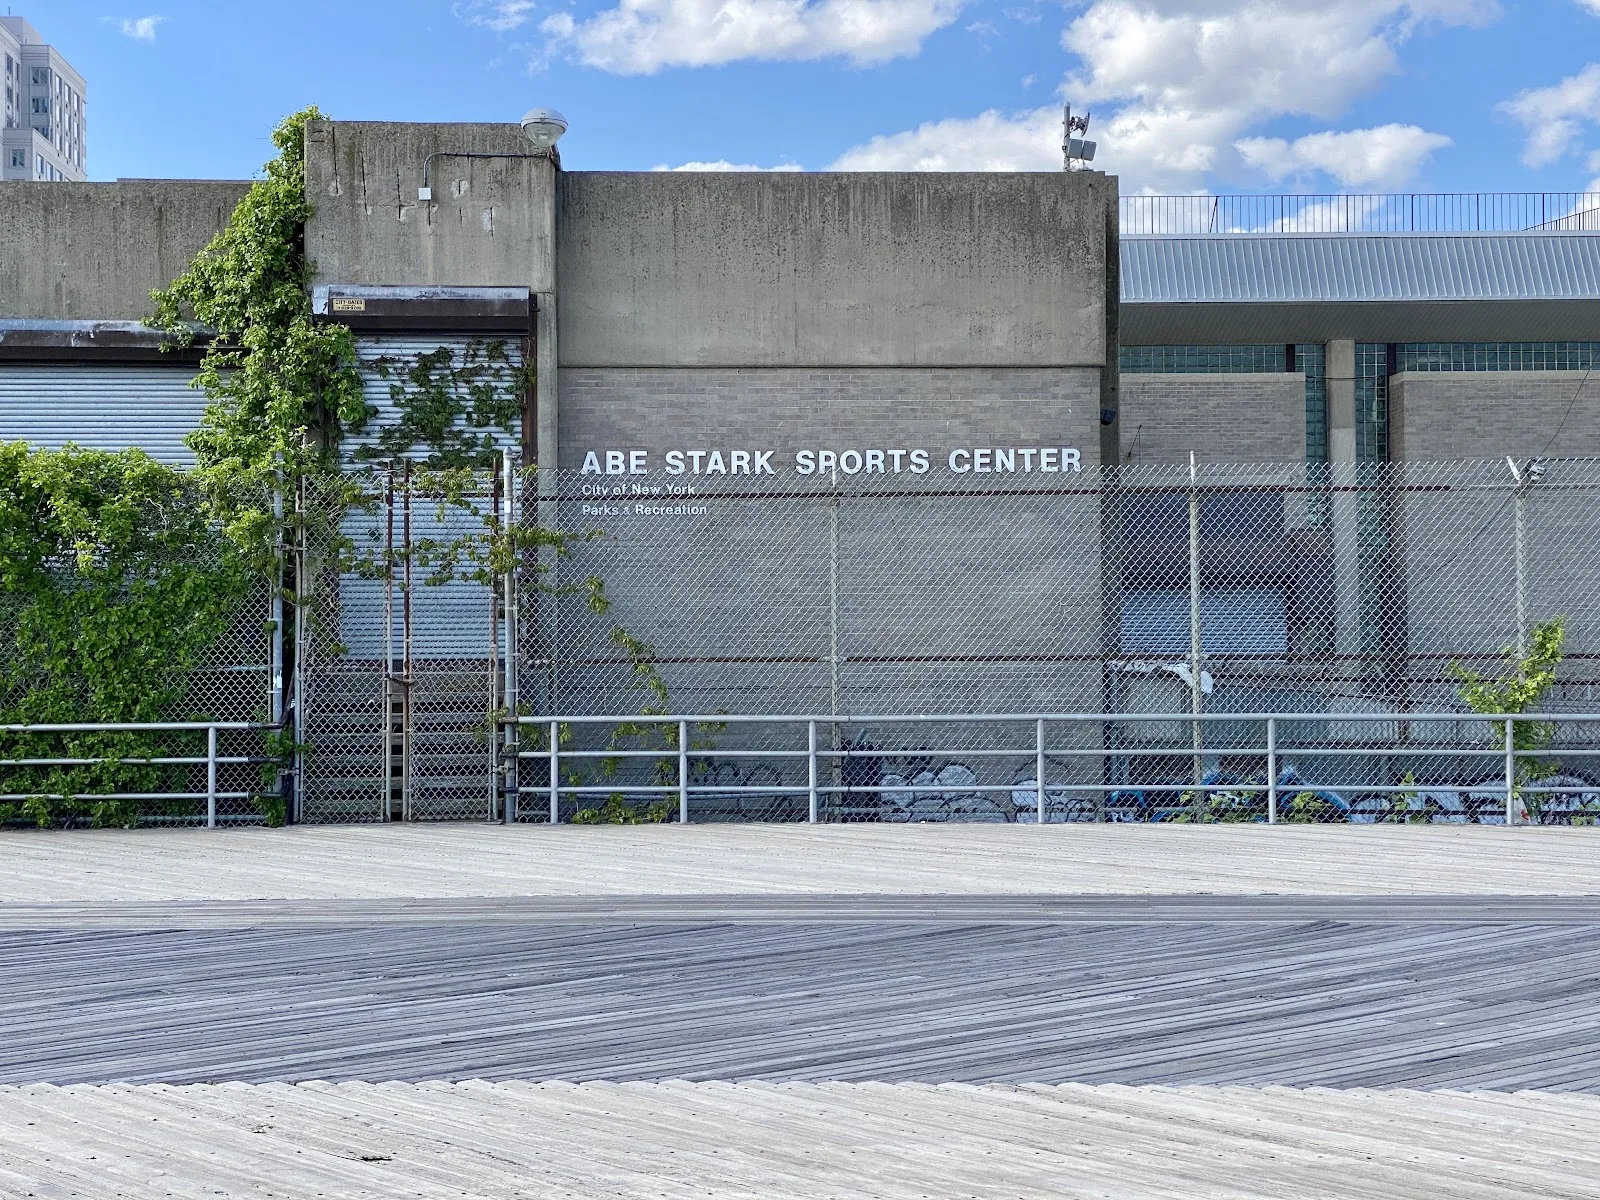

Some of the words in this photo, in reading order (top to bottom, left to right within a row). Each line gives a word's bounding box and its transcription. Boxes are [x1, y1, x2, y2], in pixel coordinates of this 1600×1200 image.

[580, 450, 648, 475] ABE
[665, 450, 775, 475] STARK
[795, 449, 930, 475] SPORTS
[948, 448, 1082, 473] CENTER
[582, 484, 608, 497] City
[613, 484, 627, 495] of
[631, 483, 661, 495] New
[666, 483, 696, 495] York
[582, 504, 619, 516] Parks
[623, 505, 631, 515] &
[635, 504, 707, 515] Recreation
